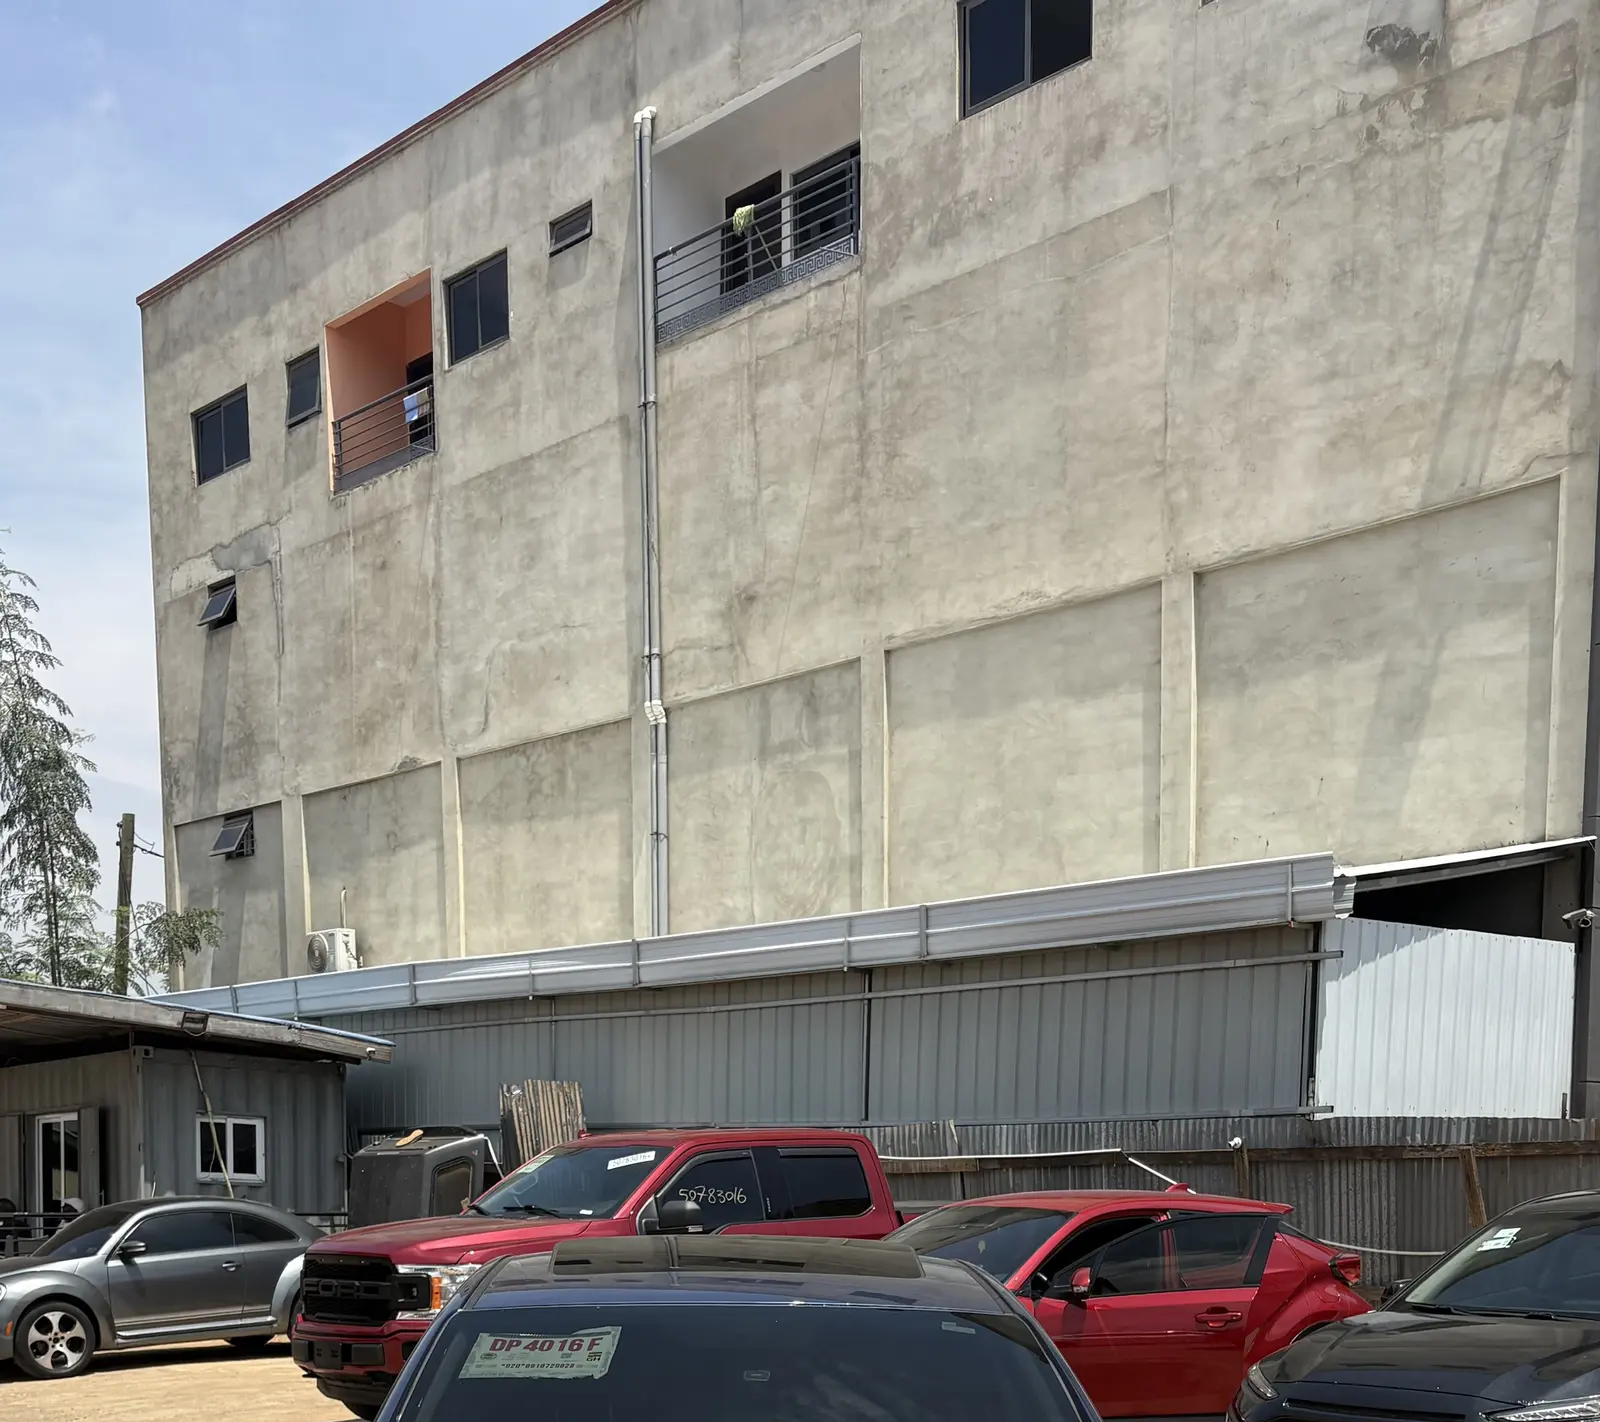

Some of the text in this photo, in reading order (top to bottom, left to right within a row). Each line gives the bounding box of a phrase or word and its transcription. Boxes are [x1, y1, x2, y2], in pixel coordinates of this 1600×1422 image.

[679, 1186, 747, 1204] 50783016
[489, 1338, 522, 1352] DP
[586, 1337, 604, 1352] F
